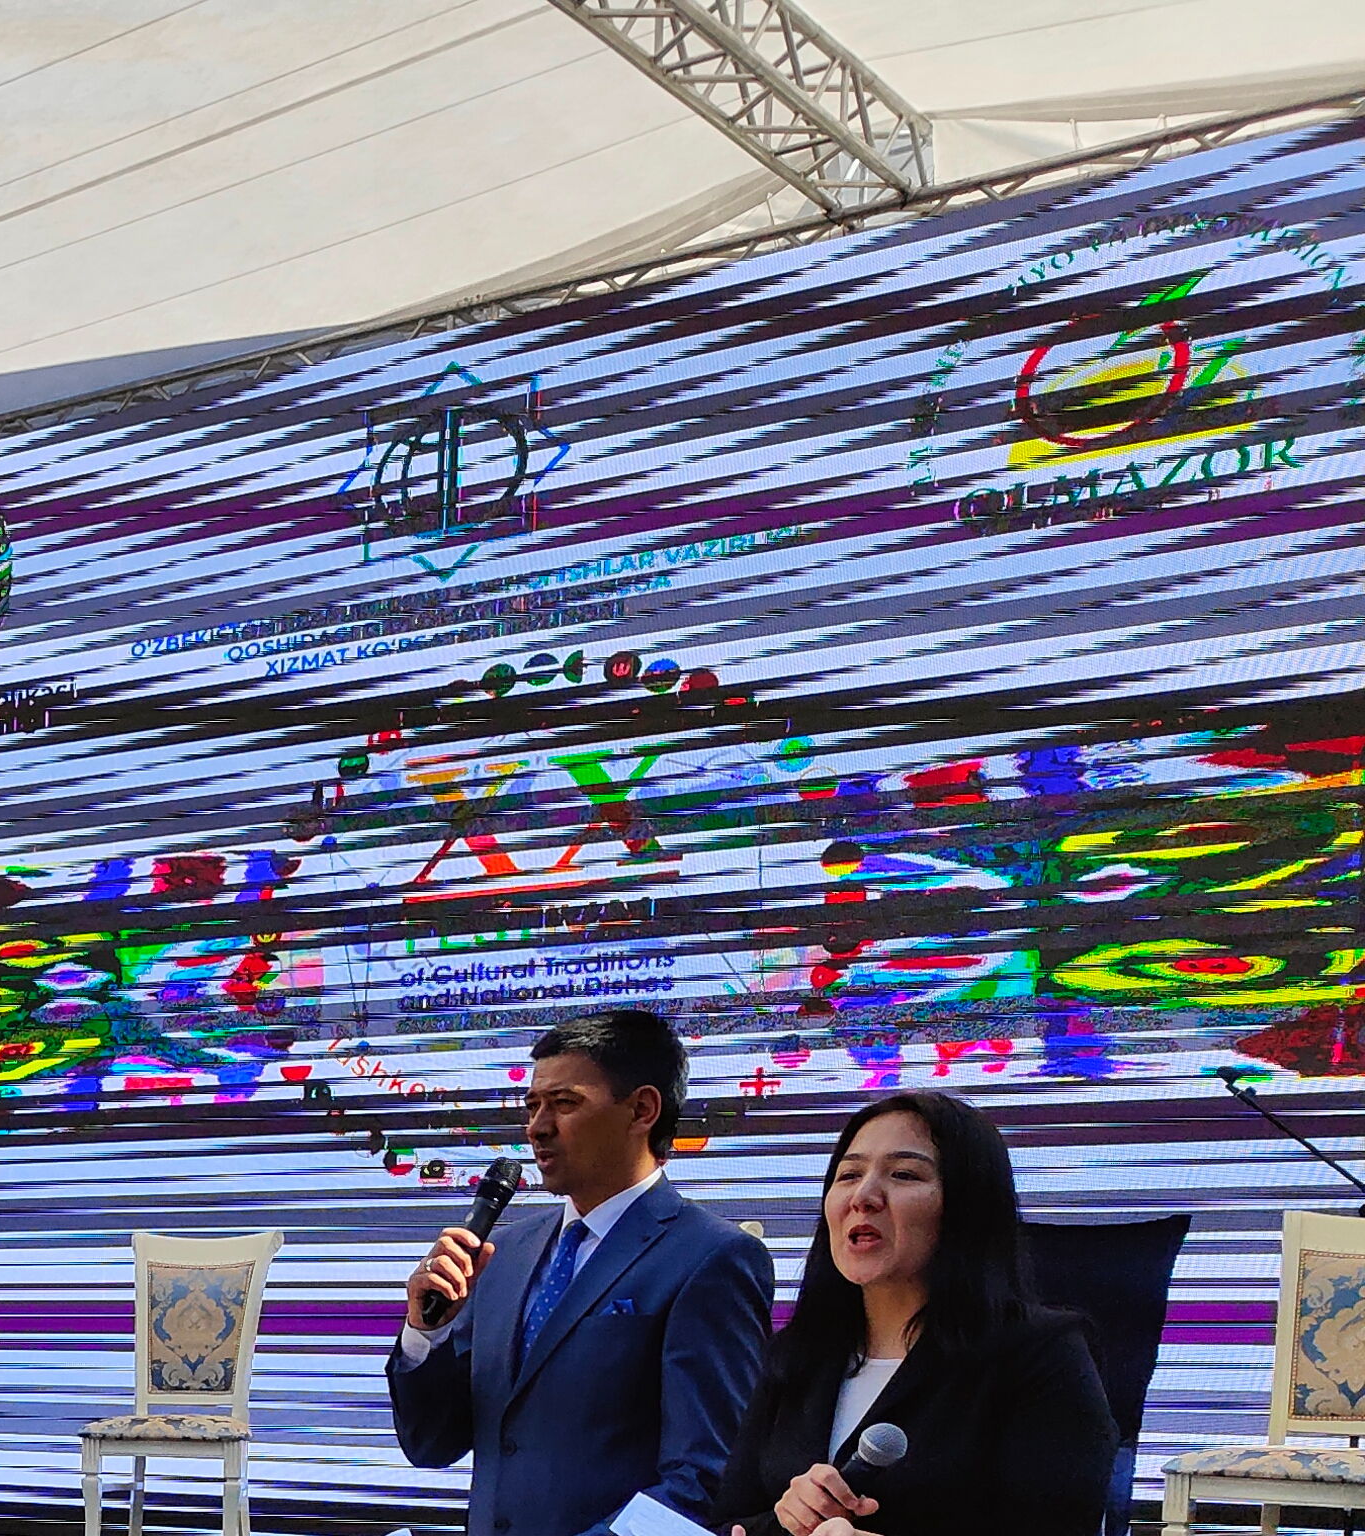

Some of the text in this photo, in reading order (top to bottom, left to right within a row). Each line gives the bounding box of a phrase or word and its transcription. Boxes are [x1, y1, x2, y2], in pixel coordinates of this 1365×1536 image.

[264, 646, 349, 677] XIZMAT
[432, 956, 536, 986] Cultural
[542, 950, 676, 977] Traditions
